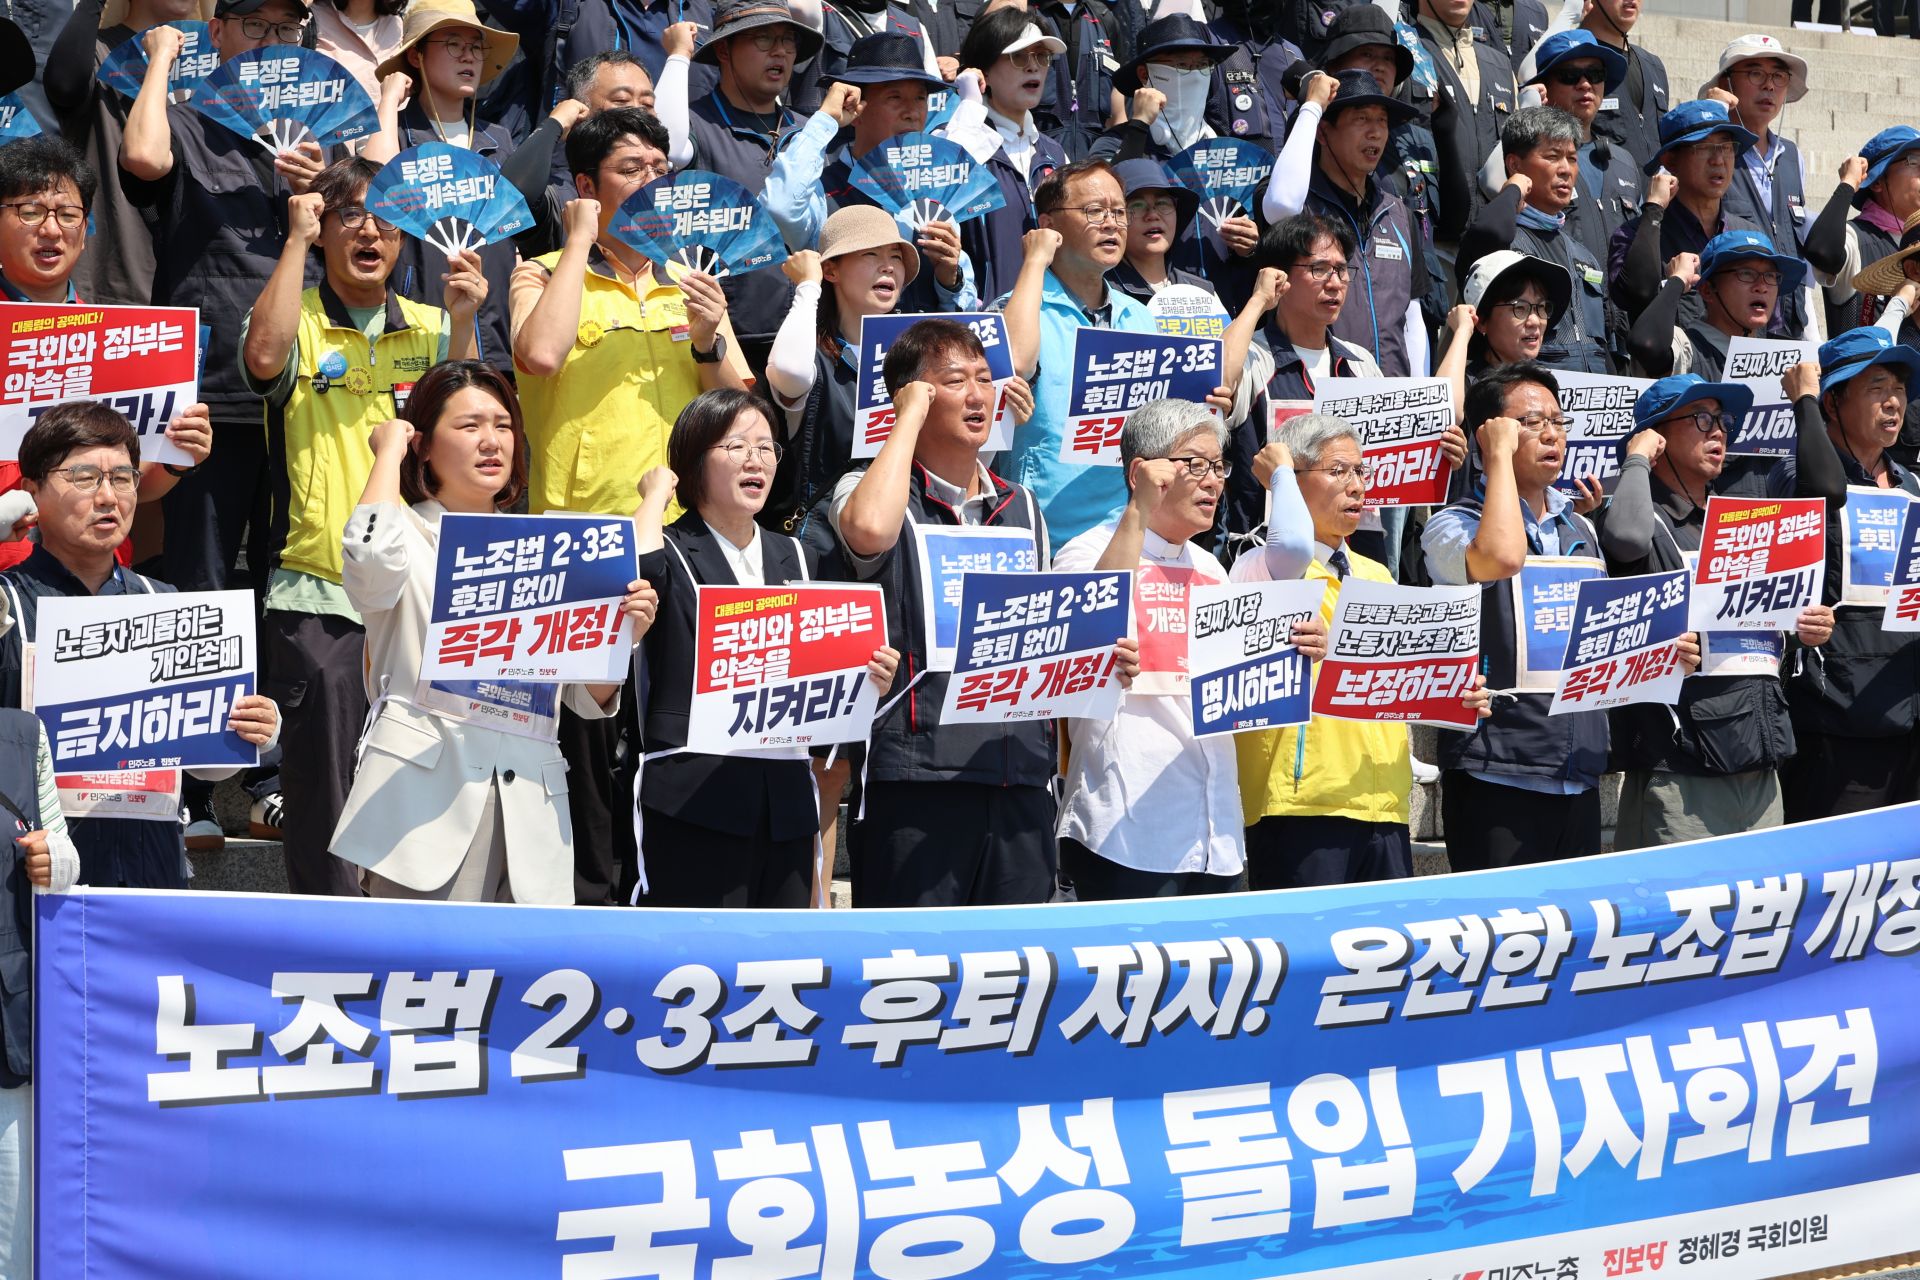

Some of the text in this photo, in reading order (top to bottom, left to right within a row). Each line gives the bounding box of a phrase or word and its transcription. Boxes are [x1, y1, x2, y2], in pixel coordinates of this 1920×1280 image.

[239, 57, 300, 85] 투쟁은
[259, 79, 345, 110] 계속된다!
[401, 154, 454, 185] 투쟁은
[887, 144, 932, 169] 투쟁은
[1194, 147, 1238, 169] 투쟁은
[422, 175, 495, 209] 계속된다!
[903, 163, 969, 191] 계속된다!
[654, 183, 711, 211] 투쟁은
[672, 206, 753, 237] 계속된다!
[11, 311, 104, 334] 대통령의 공약이다!
[8, 331, 97, 370] 국회와
[103, 321, 183, 361] 정부는
[1085, 342, 1216, 383] 노조법 2·3조
[1730, 351, 1768, 378] 진짜
[3, 364, 93, 405] 약속을
[1082, 379, 1171, 413] 후퇴 없이
[1571, 385, 1639, 412] 괴롭히는
[1367, 416, 1419, 444] 노조할
[1415, 408, 1452, 437] 권리!
[1584, 410, 1637, 437] 개인손
[1718, 504, 1782, 523] 대통령의 공약이다!
[1856, 507, 1898, 526] 노조법
[1714, 510, 1822, 554] 국회와 정부는
[1858, 527, 1896, 552] 후퇴
[452, 523, 625, 581] 노조법 2·3조
[941, 553, 992, 574] 노조법
[1707, 549, 1770, 584] 약속을
[448, 571, 567, 617] 후퇴 없이
[714, 592, 798, 618] 대통령의 공약이다!
[973, 576, 1119, 635] 노조법 2·3조
[1139, 581, 1186, 603] 온전한
[1533, 581, 1579, 604] 노조법
[1580, 574, 1685, 634] 노조법 2·3조
[1716, 568, 1816, 621] 지켜라!
[712, 601, 873, 655] 국회와 정부는
[1146, 606, 1187, 634] 개정
[1195, 592, 1262, 639] 진짜 사장
[55, 604, 223, 663] 노동자 괴롭히는
[438, 603, 626, 668] 즉각 개정!
[969, 623, 1070, 668] 후퇴 없이
[1243, 618, 1277, 656] 원청
[1335, 629, 1400, 657] 노동자
[1398, 626, 1456, 656] 노조할
[1575, 619, 1652, 664] 후퇴 없이
[149, 634, 243, 683] 개인손배
[508, 667, 558, 676] 민주노총 진보당
[710, 647, 791, 690] 약속을
[1561, 643, 1680, 702] 즉각 개정!
[476, 681, 533, 707] 국회농성단
[956, 651, 1118, 712] 즉각 개정!
[1202, 654, 1303, 724] 명시하라!
[1330, 661, 1478, 707] 보장하라!
[480, 703, 530, 723] 민주노총 진보당
[727, 671, 867, 738] 지켜라!
[56, 683, 246, 761] 금지하라!
[769, 736, 793, 745] 민주노총
[128, 756, 182, 769] 민주노총 진보당
[90, 792, 147, 803] 민주노총 진보당
[147, 968, 502, 1109] 노조법
[510, 958, 831, 1084] 2·3조
[841, 946, 1059, 1069] 후퇴
[1058, 936, 1289, 1048] 저지!
[1313, 904, 1575, 1030] 온전한
[1570, 872, 1808, 997] 노조법
[555, 1007, 1879, 1280] 국회농성 돌입 기자회견
[1602, 1240, 1669, 1278] 진보당
[1677, 1229, 1741, 1266] 정혜경
[1747, 1213, 1829, 1253] 국회의원
